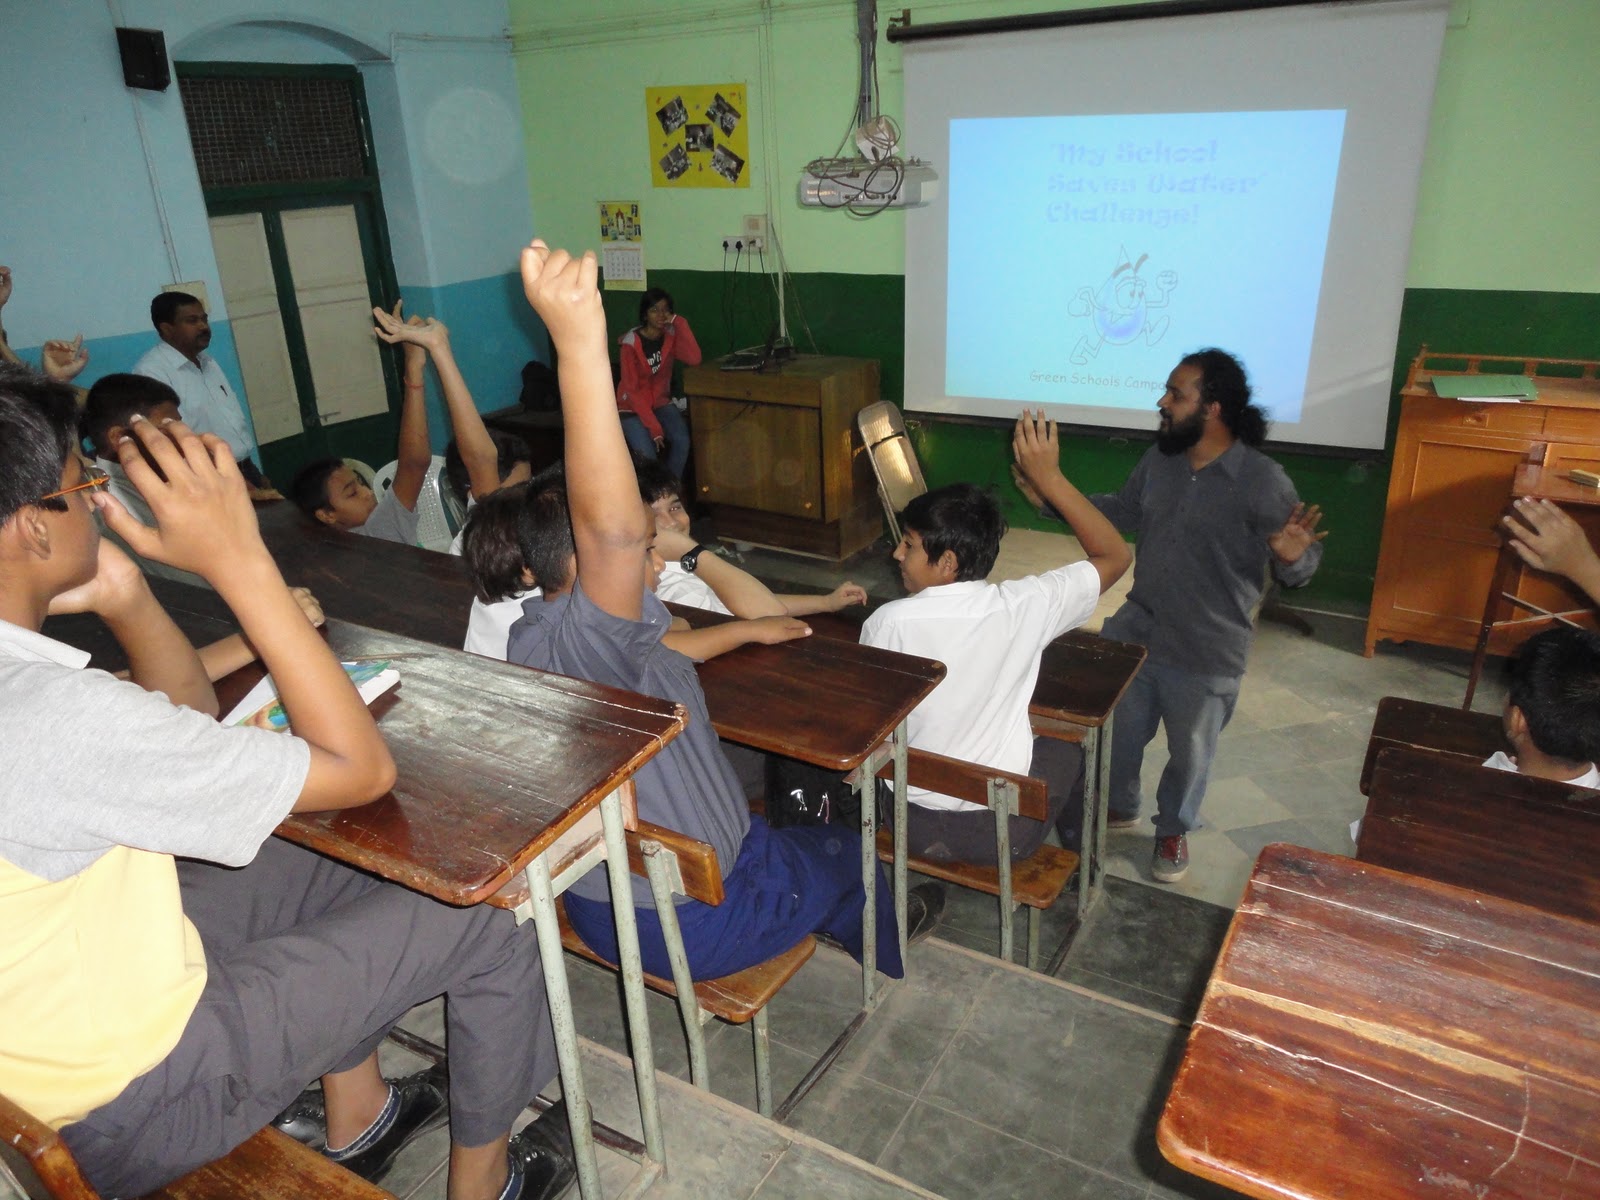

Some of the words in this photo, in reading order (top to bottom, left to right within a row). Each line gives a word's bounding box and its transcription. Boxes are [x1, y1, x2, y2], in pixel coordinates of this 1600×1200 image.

[1115, 139, 1218, 164] School
[1047, 173, 1137, 193] Saves
[1045, 200, 1200, 229] Challenge!
[1029, 370, 1067, 383] Green
[1070, 373, 1121, 388] Schools
